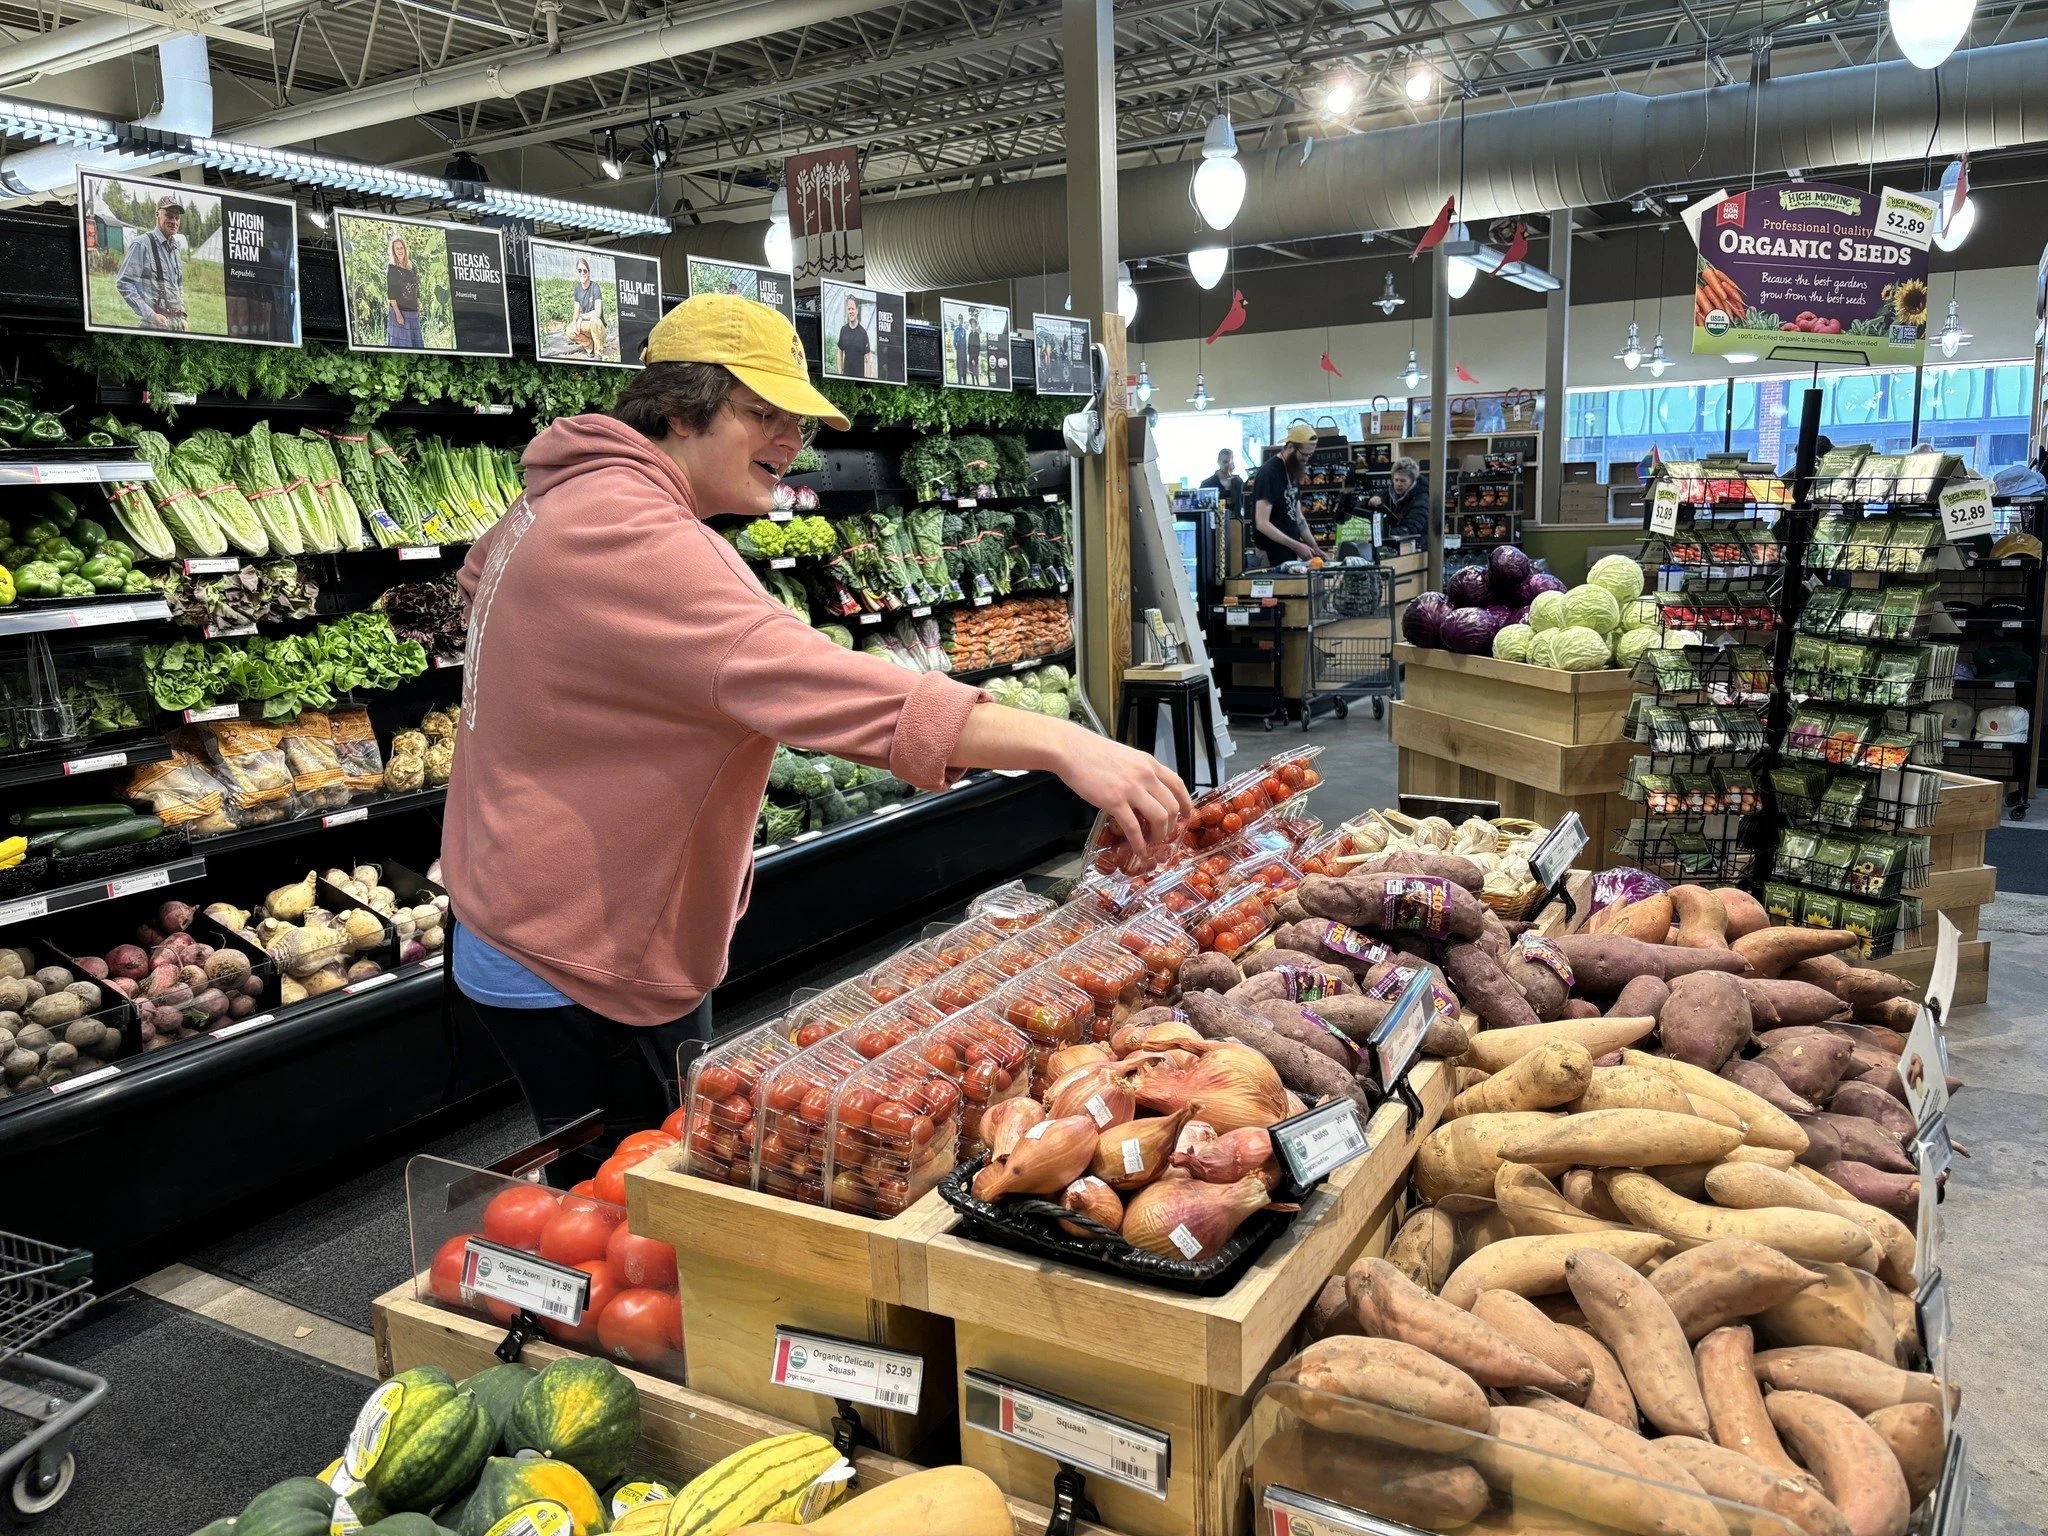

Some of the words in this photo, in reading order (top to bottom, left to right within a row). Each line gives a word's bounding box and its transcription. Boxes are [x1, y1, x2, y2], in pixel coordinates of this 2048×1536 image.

[1788, 192, 1812, 202] HIGH
[1814, 193, 1852, 207] MOWING
[228, 210, 264, 231] VIRGIN
[1763, 218, 1830, 234] Professional
[1832, 224, 1873, 239] Quality
[1887, 211, 1925, 234] $2.89
[228, 227, 264, 248] EARTH
[229, 244, 260, 262] FARM
[1719, 230, 1832, 260] ORGANIC
[1838, 238, 1912, 266] SEEDS
[452, 252, 490, 270] TREASA'S
[230, 268, 256, 278] Republic
[453, 266, 501, 284] TREASURES
[619, 280, 636, 293] FULL
[636, 282, 656, 296] PLATE
[760, 280, 778, 293] LITTLE
[1762, 272, 1792, 284] Because
[1794, 274, 1810, 286] the
[1814, 274, 1832, 286] best
[1834, 276, 1868, 293] gardens
[620, 292, 639, 306] FARM
[760, 292, 784, 304] PARSLEY
[1760, 290, 1782, 304] grow
[1784, 288, 1807, 302] from
[1809, 291, 1824, 302] the
[1826, 292, 1845, 304] best
[1846, 293, 1867, 305] seeds
[1754, 334, 1778, 342] Certified
[1836, 338, 1856, 347] Project
[1856, 339, 1878, 347] Verified
[1656, 505, 1672, 521] $2.89
[1950, 505, 1985, 524] $2.89
[500, 1262, 522, 1275] Organic
[522, 1269, 541, 1280] Acorn
[506, 1274, 529, 1288] Squash
[551, 1278, 572, 1292] $1.99
[813, 1350, 843, 1363] Organic
[844, 1354, 875, 1369] Delicata
[828, 1364, 857, 1377] Squash
[885, 1363, 913, 1378] $2.99
[800, 1376, 816, 1384] Mexico
[1028, 1428, 1046, 1440] Mexico
[1056, 1416, 1088, 1436] Squash
